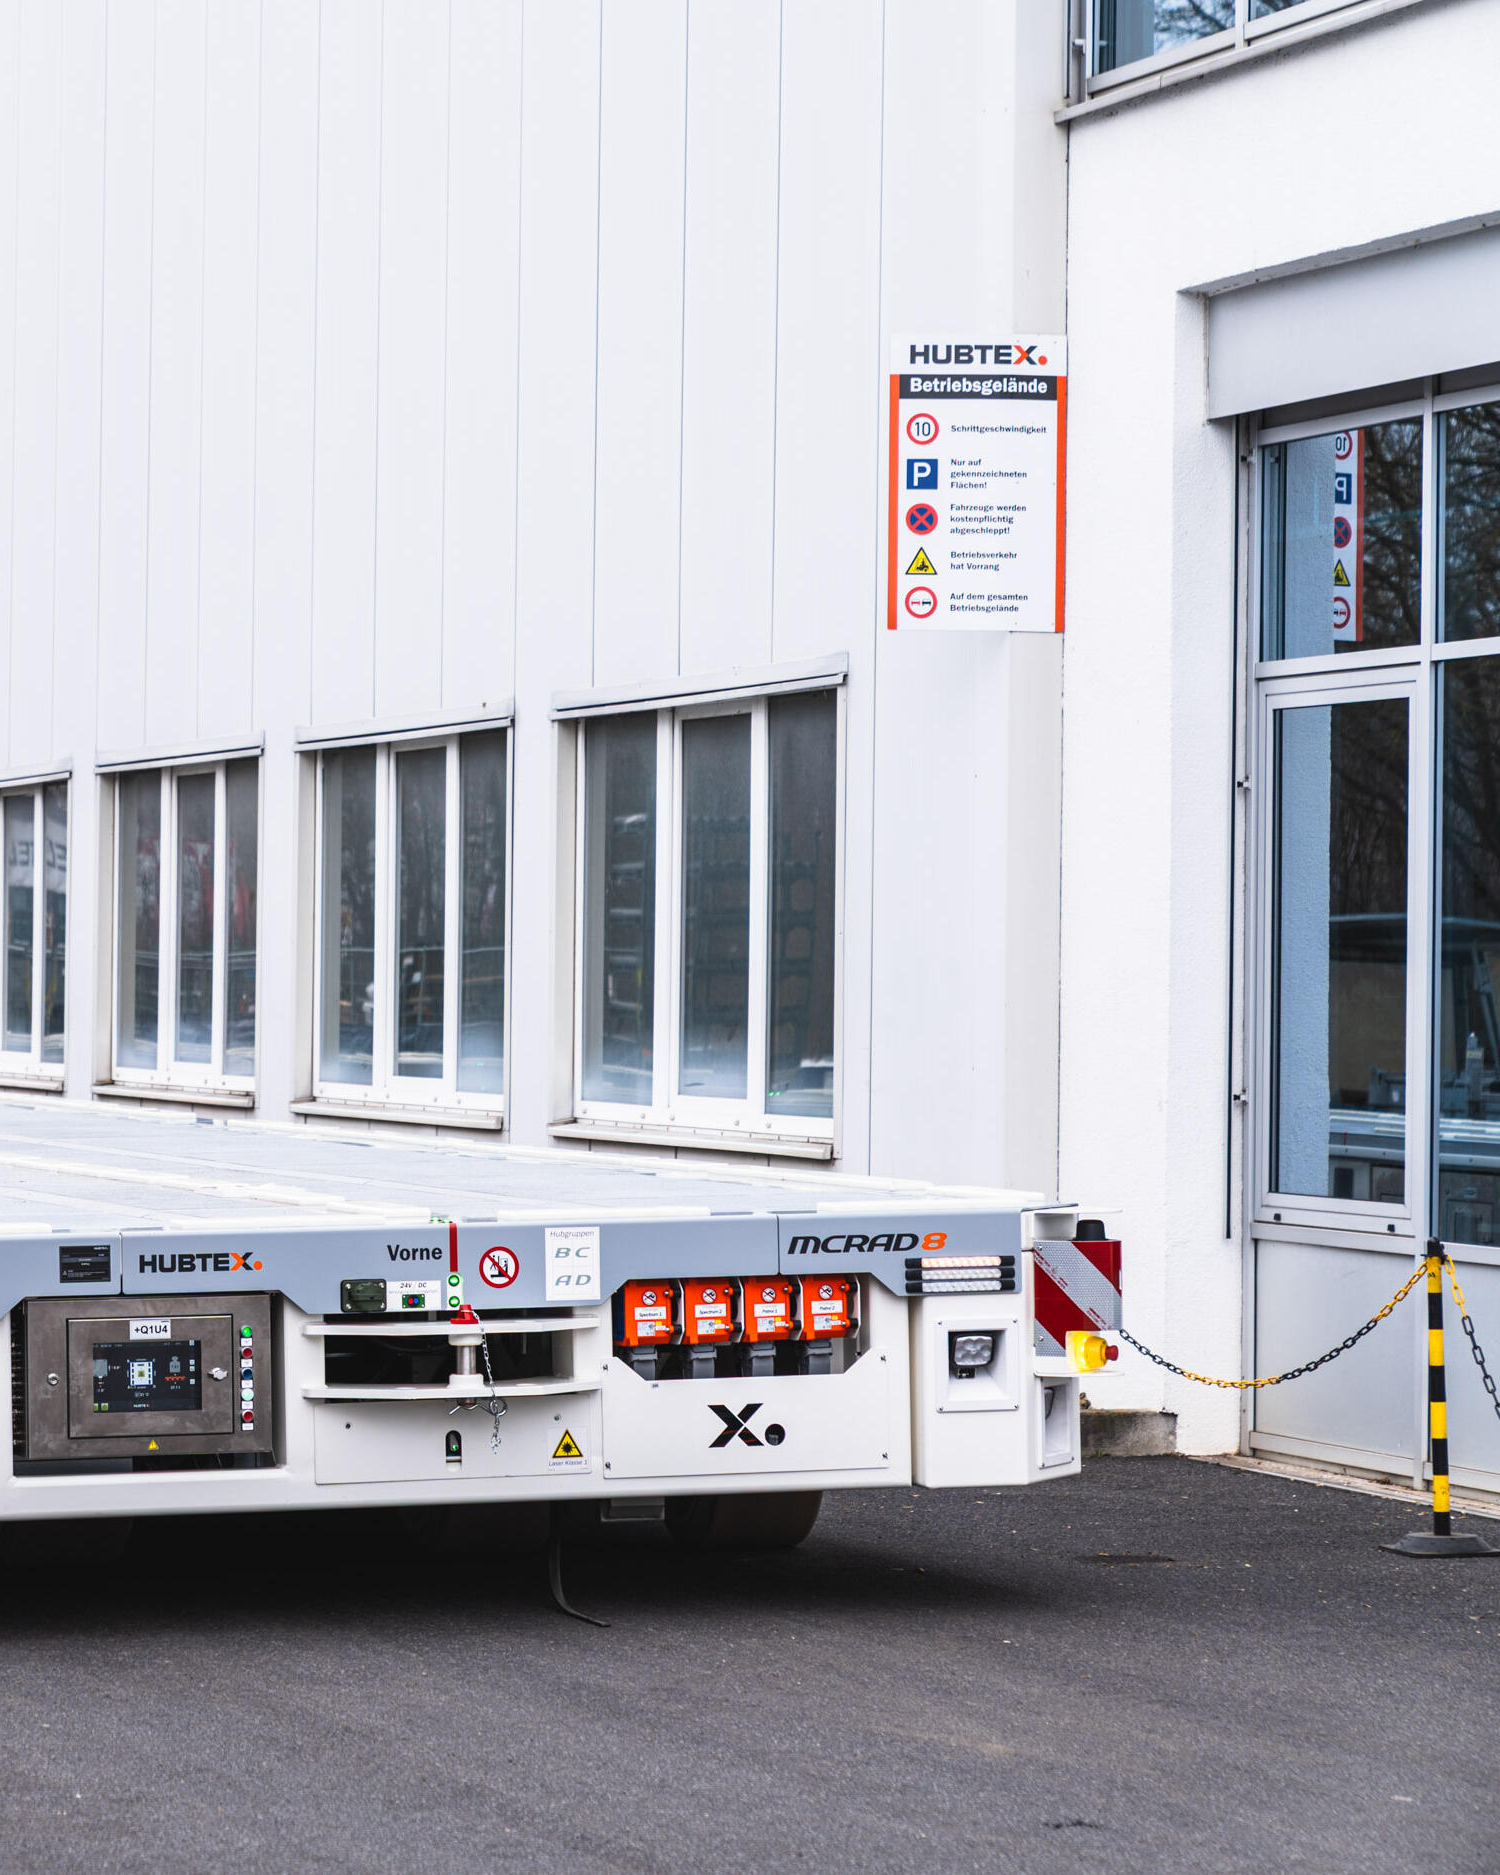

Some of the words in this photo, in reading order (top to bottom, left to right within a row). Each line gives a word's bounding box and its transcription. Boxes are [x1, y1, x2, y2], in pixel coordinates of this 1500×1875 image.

[909, 377, 1048, 396] Betriebsgelände
[914, 421, 931, 437] 10
[950, 424, 1047, 434] Schrittgeschwindigkeit
[913, 461, 932, 487] P
[950, 470, 1028, 479] gekennzeichneten
[950, 503, 994, 512] Fahrzeuge
[996, 504, 1027, 512] werden
[950, 515, 1014, 524] kostenpflichtig
[950, 526, 1010, 535] abgeschleppt!
[950, 551, 1018, 559] Betriebsverkehr
[966, 563, 1000, 571] Vorrang
[987, 593, 1029, 601] gesamten
[950, 604, 1019, 613] Betriebsgelände
[550, 1230, 595, 1239] Hubgruppen
[387, 1245, 443, 1261] Vorne
[134, 1325, 168, 1335] +Q1U4
